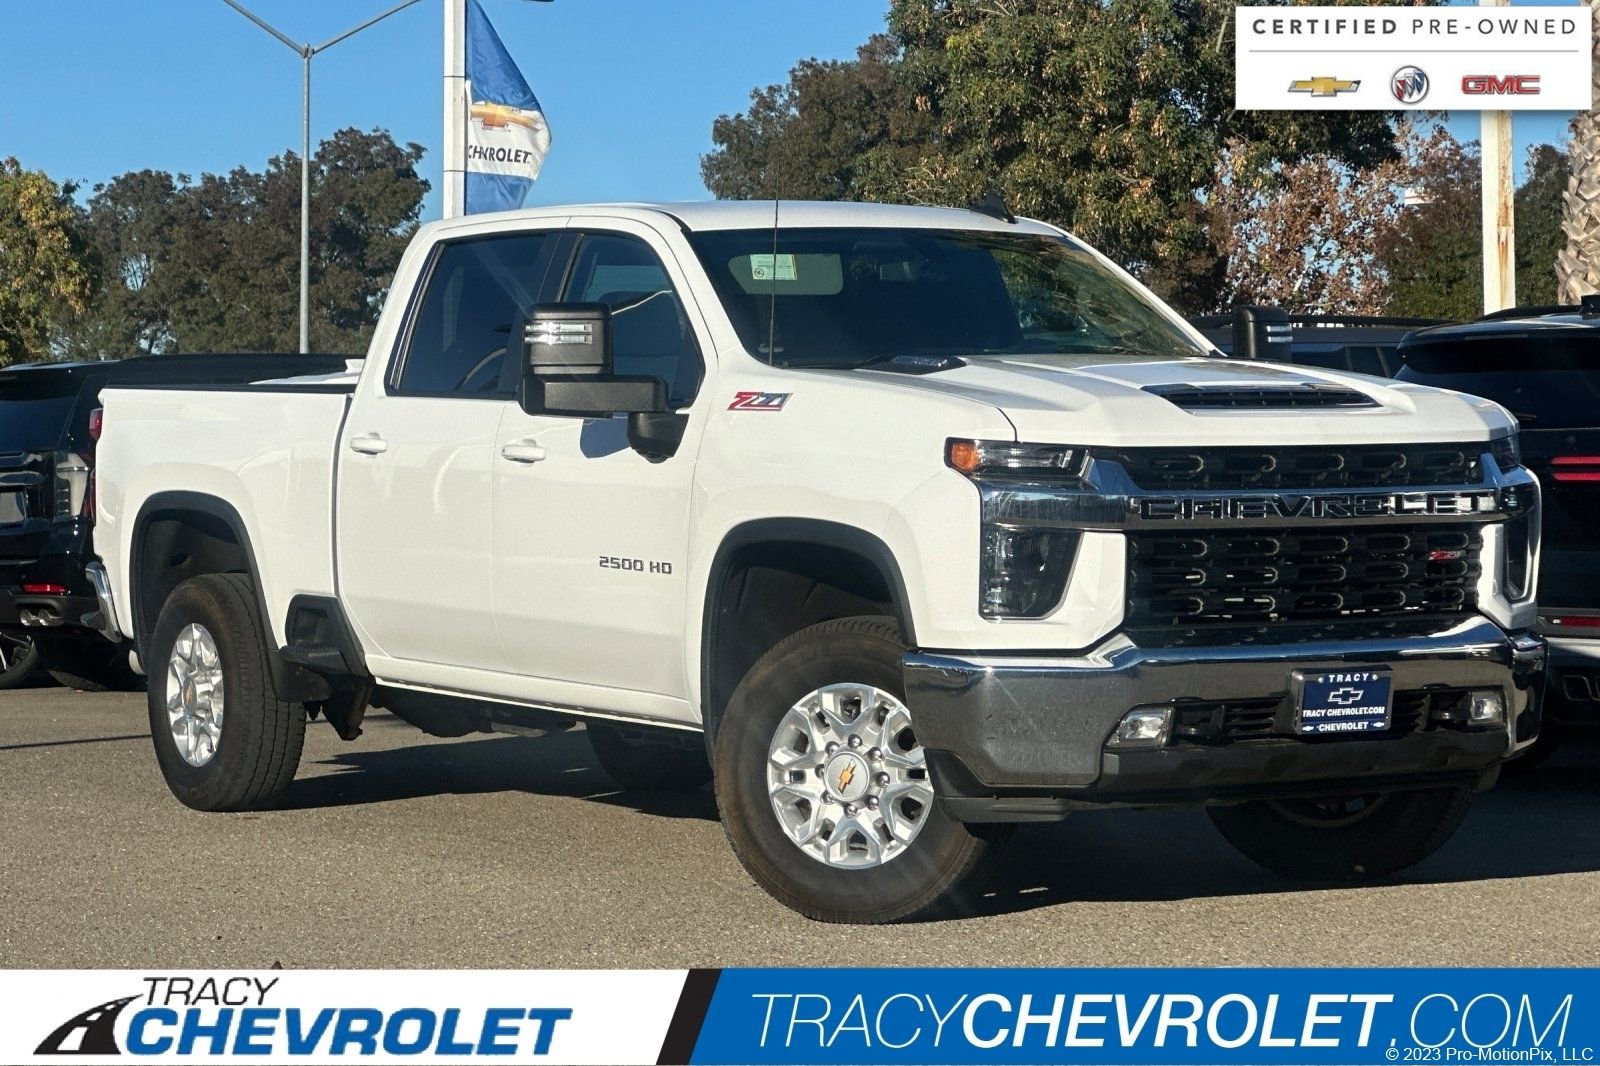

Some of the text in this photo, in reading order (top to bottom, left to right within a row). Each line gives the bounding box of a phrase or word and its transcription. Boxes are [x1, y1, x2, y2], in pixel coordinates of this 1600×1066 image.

[727, 391, 794, 411] Z71
[1138, 491, 1497, 521] CHEVROLET
[599, 556, 672, 574] 2500 HD
[1328, 673, 1369, 683] TRACY
[1302, 706, 1385, 718] TRACY CHEVROLET.COM
[1318, 722, 1369, 731] CHEVROLET
